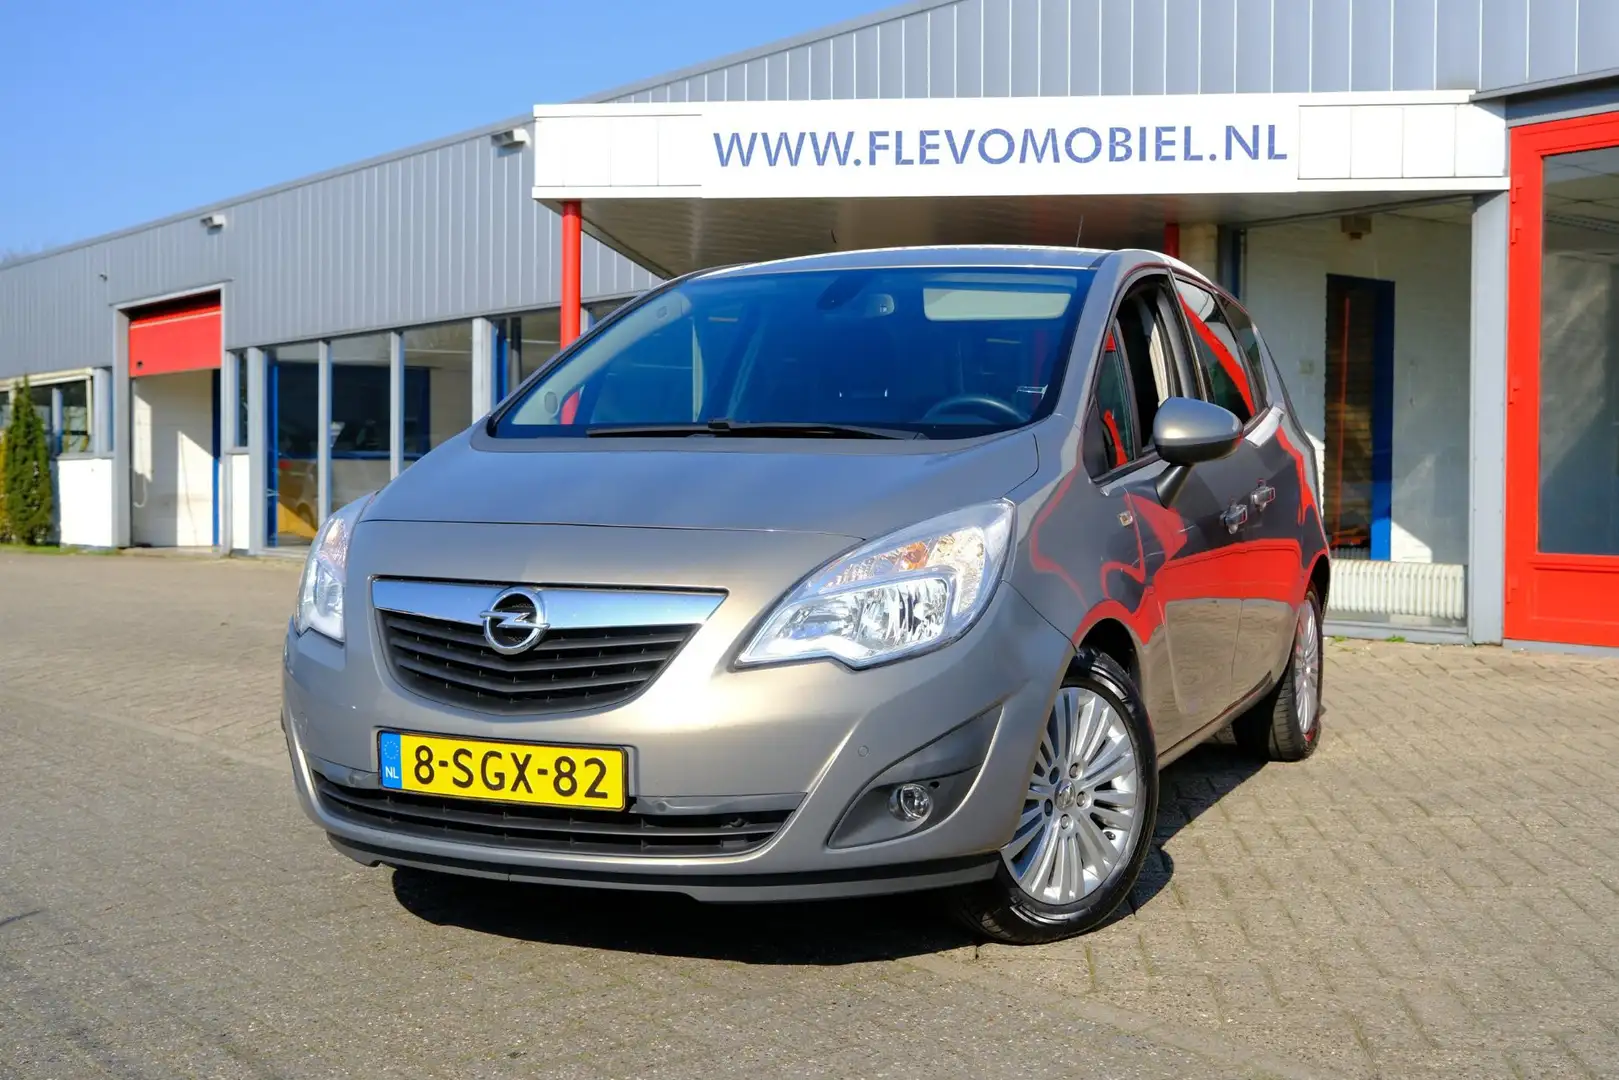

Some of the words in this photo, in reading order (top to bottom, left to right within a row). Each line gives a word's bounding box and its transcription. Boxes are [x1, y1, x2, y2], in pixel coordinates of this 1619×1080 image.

[713, 124, 1288, 167] WWW.FLEVOMOBIEL.NL
[385, 766, 399, 780] NL
[414, 745, 608, 799] 8-SGX-82
